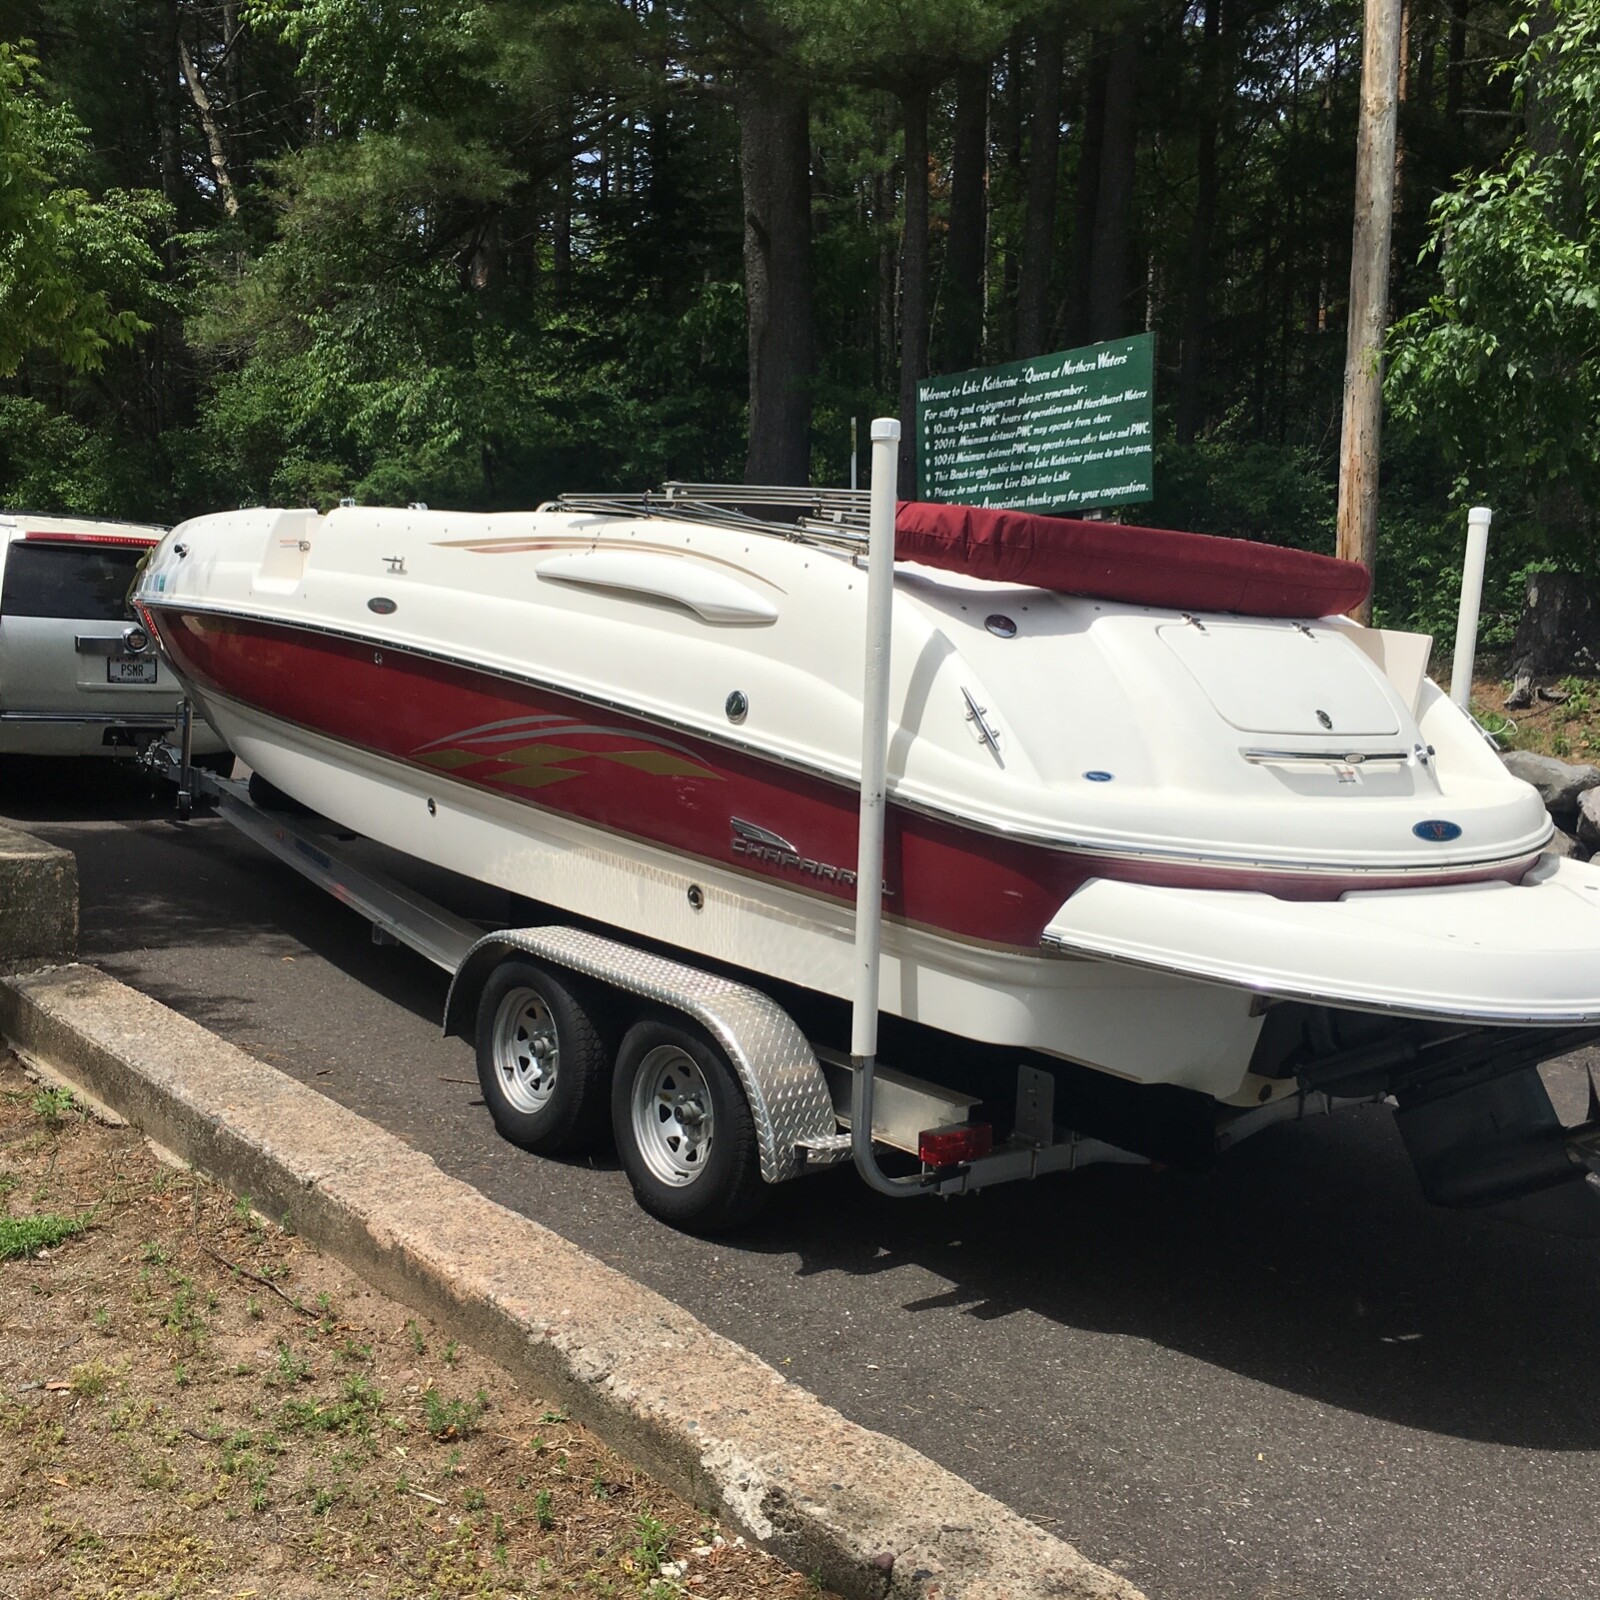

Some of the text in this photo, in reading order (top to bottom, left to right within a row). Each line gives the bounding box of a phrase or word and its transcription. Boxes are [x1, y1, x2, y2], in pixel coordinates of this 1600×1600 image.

[920, 387, 950, 402] Welcome
[952, 386, 960, 396] to
[962, 381, 980, 395] Lake
[982, 376, 1018, 392] Katherine
[1051, 367, 1060, 378] of
[1061, 360, 1096, 377] Northern
[924, 384, 1088, 421] For safty and enjoyment please remember:
[980, 414, 1000, 428] PWC
[1000, 413, 1020, 424] hours
[1022, 410, 1031, 420] of
[1031, 405, 1063, 421] operation
[1084, 393, 1123, 409] Hazelhurst
[1124, 389, 1147, 401] Waters
[956, 451, 986, 463] Minimum
[1011, 442, 1029, 454] PWC
[1028, 444, 1041, 455] may
[1042, 438, 1065, 450] operate
[1065, 437, 1080, 447] from
[1081, 432, 1097, 444] other
[1099, 431, 1116, 441] boats
[1116, 427, 1130, 438] and
[958, 434, 989, 446] Minimum
[990, 430, 1016, 442] distance
[1015, 425, 1033, 438] PWC
[1032, 426, 1048, 436] may
[1048, 420, 1073, 434] operate
[1074, 417, 1091, 428] from
[1093, 413, 1112, 424] shore
[934, 471, 948, 482] This
[950, 469, 969, 480] Beach
[970, 467, 976, 476] is
[976, 466, 989, 480] only
[989, 462, 1009, 476] public
[1010, 461, 1023, 471] land
[1034, 457, 1049, 468] Lake
[1050, 452, 1082, 467] Katherine
[1082, 450, 1104, 464] please
[1104, 448, 1113, 458] do
[1113, 447, 1124, 456] not
[934, 470, 1071, 497] Please do not release Live Bait into Lake
[982, 496, 1024, 509] Association
[1026, 491, 1052, 506] thanks
[1052, 493, 1067, 507] you
[1067, 490, 1080, 502] for
[1080, 489, 1100, 503] your
[121, 664, 143, 676] PSMR
[731, 838, 895, 895] CHAPARRL
